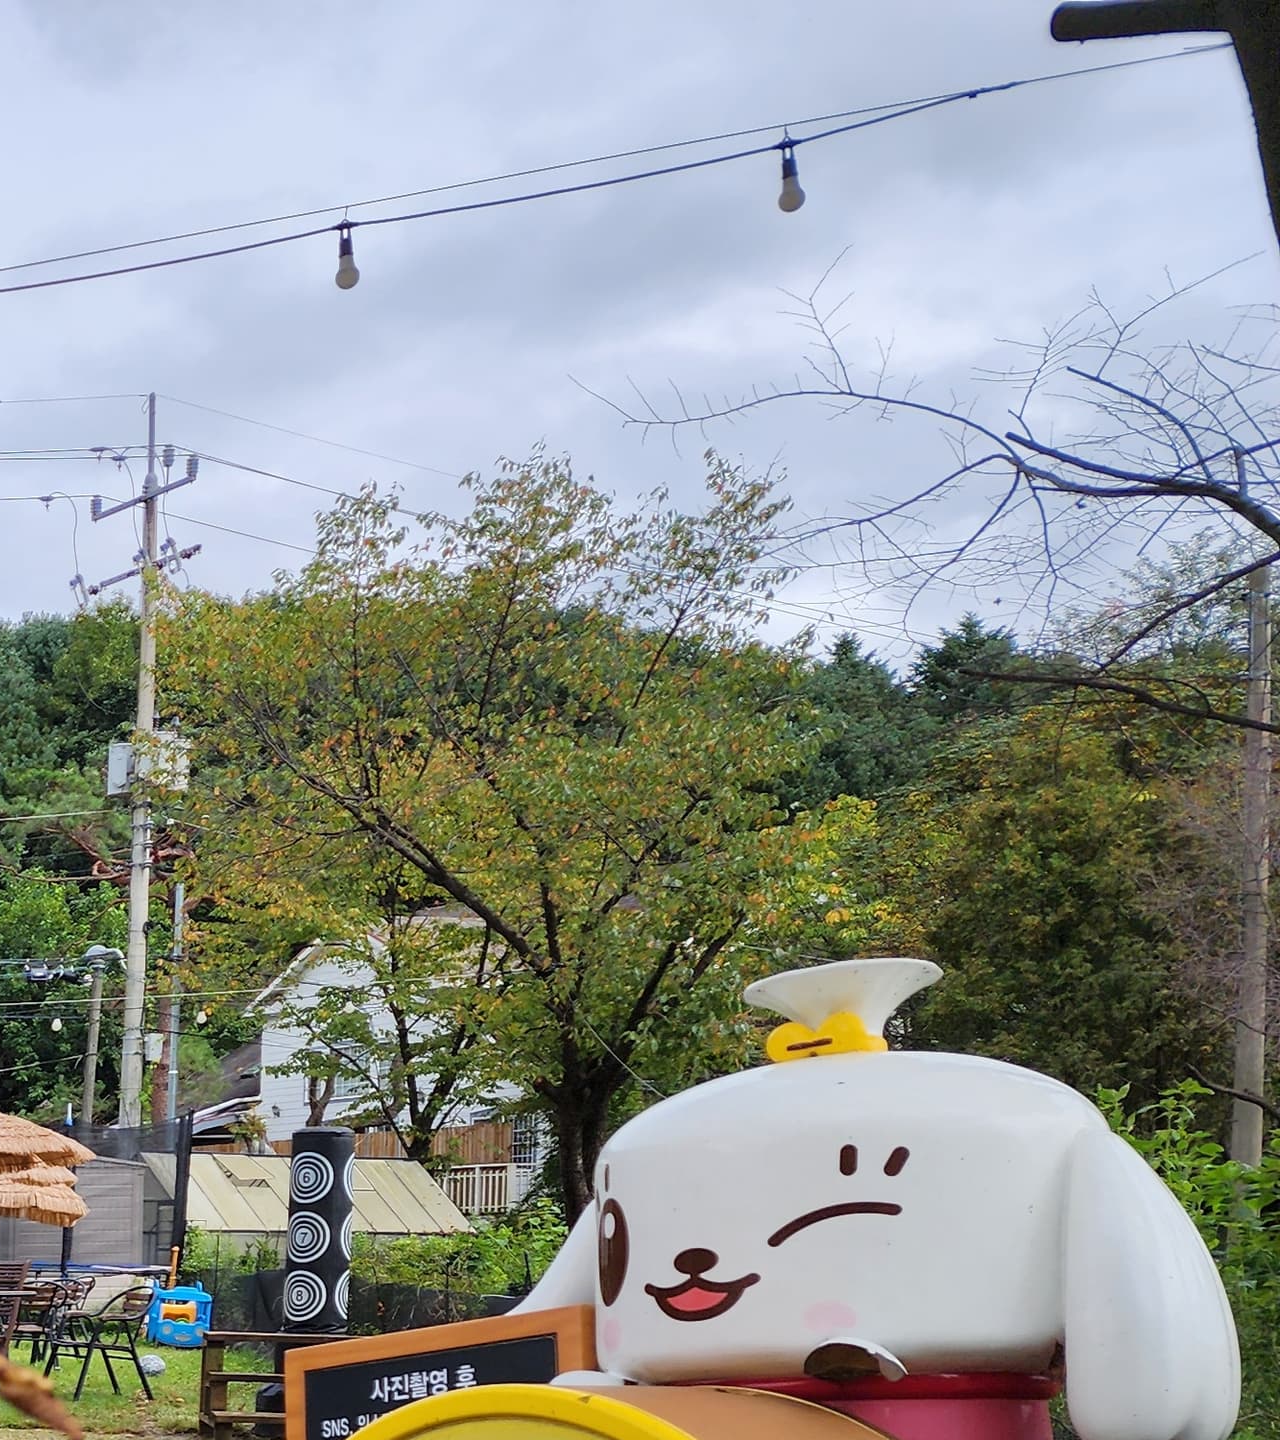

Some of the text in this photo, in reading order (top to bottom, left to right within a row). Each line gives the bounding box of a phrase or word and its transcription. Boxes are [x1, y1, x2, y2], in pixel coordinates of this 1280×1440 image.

[302, 1171, 311, 1184] 6
[300, 1232, 308, 1243] 7
[296, 1290, 304, 1301] 8
[370, 1368, 448, 1403] 사진촬영
